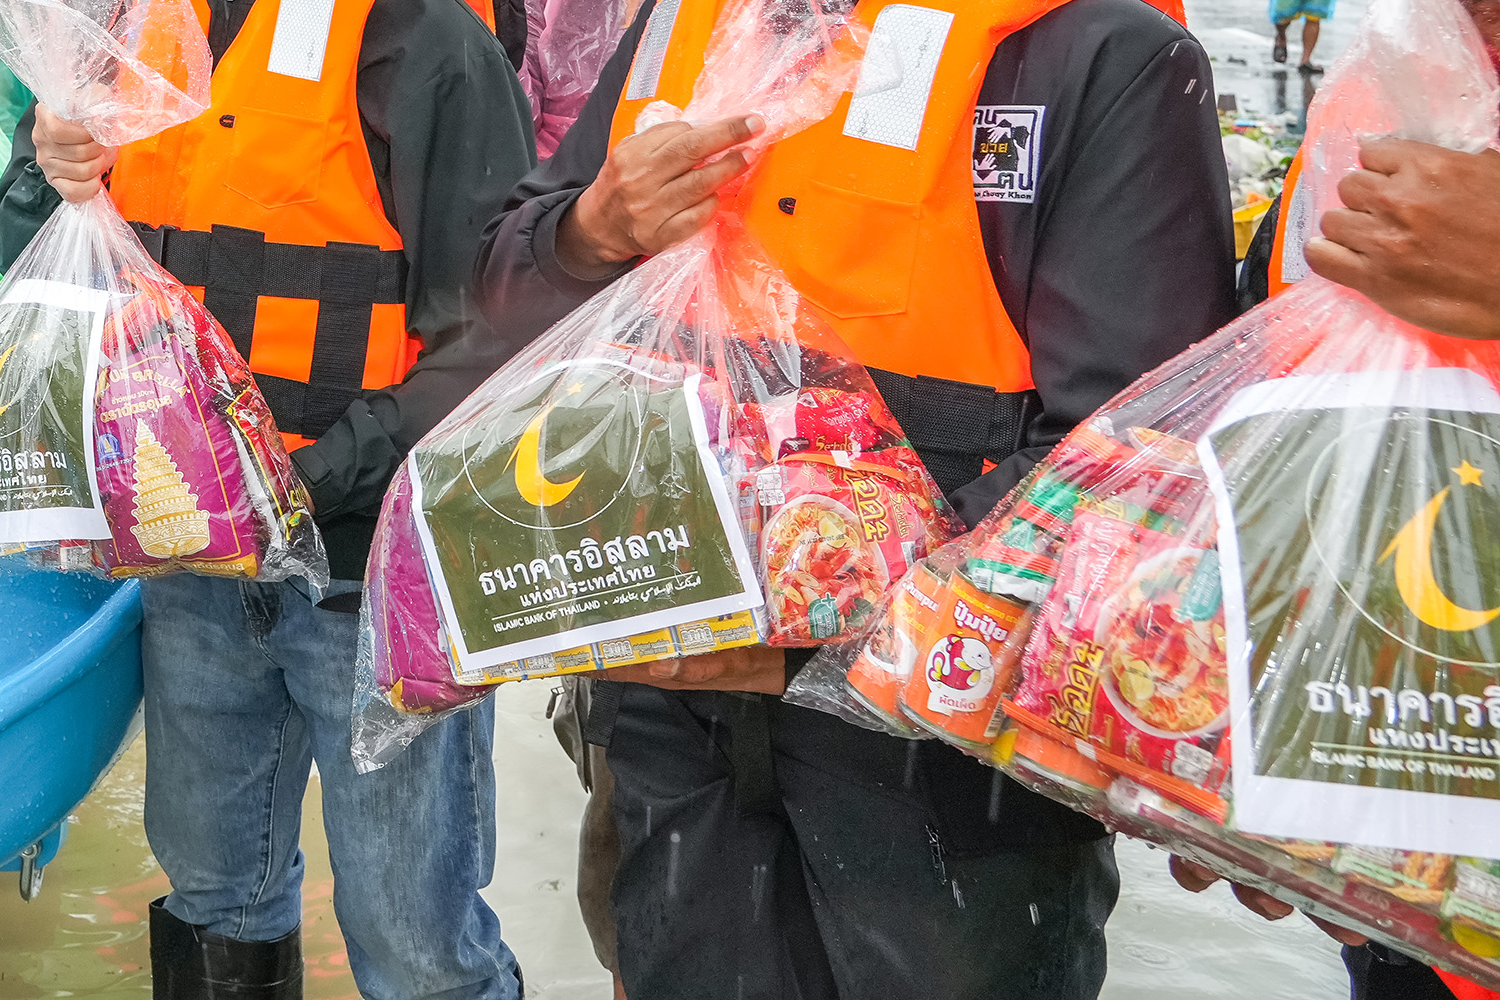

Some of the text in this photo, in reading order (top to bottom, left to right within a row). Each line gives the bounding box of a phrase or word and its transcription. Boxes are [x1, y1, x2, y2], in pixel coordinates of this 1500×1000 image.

[1008, 189, 1032, 199] Khon
[478, 524, 691, 596] ธนาคารอิสลาม
[519, 563, 657, 608] แห่งประเทศไทย
[493, 600, 601, 633] ISLAMIC BANK OF THAILAND
[953, 598, 1010, 642] ปุ้มปุ้ย
[1405, 759, 1428, 774] OF
[1427, 761, 1497, 782] THAILAND
